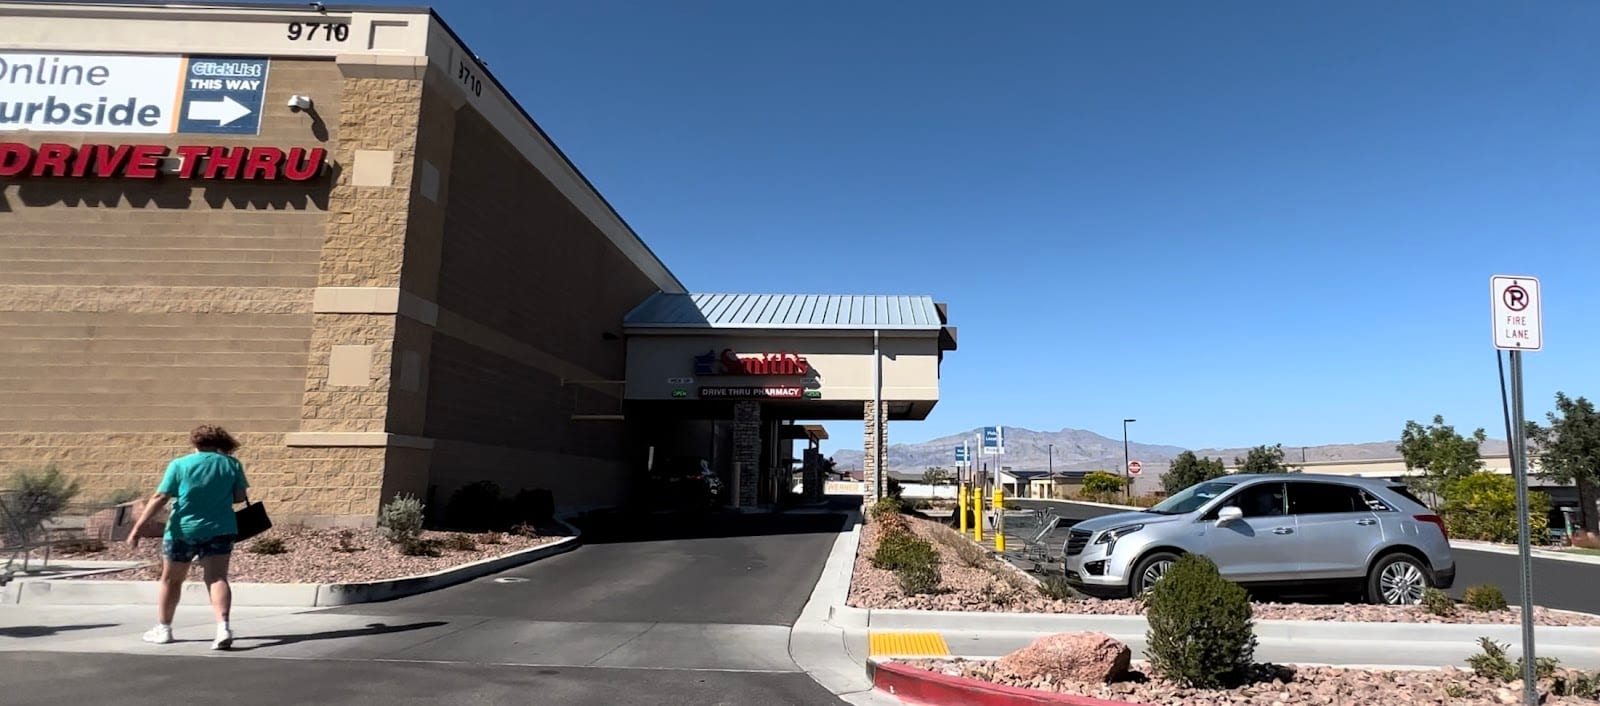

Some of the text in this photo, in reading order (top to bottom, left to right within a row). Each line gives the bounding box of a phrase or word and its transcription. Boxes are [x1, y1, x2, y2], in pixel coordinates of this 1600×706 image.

[287, 22, 349, 42] 9710
[192, 62, 261, 77] ClickList
[190, 79, 261, 91] THIS WAY
[0, 142, 326, 182] DRIVE THRU
[1507, 315, 1527, 325] FIRE
[1505, 329, 1530, 340] LANE
[720, 349, 808, 376] Smith's
[701, 387, 801, 398] DRIVE THRU PHARMACY
